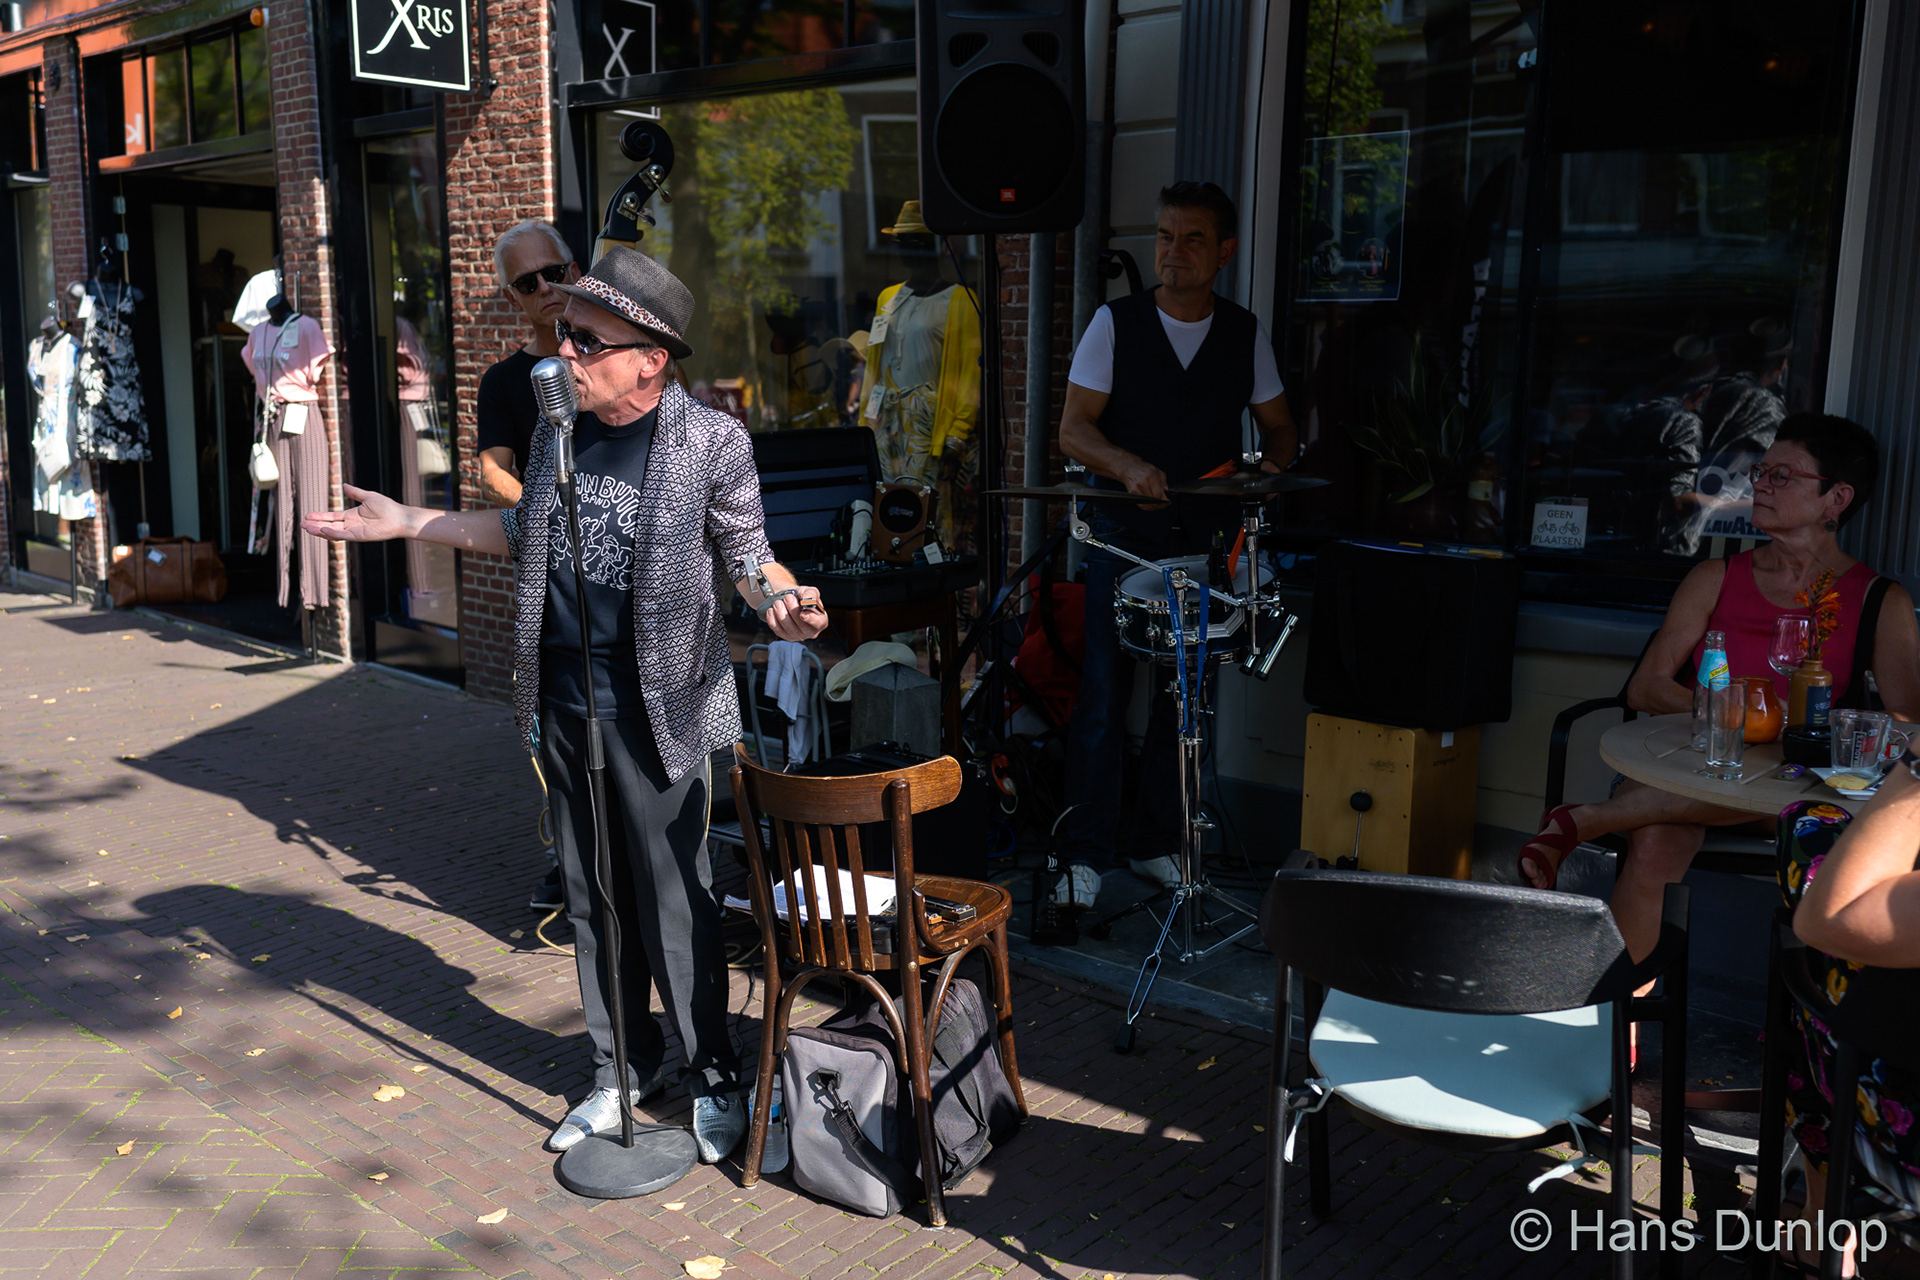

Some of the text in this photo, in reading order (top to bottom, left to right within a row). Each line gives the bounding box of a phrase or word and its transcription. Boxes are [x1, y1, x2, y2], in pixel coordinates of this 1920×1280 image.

[581, 493, 611, 509] BAND
[1547, 509, 1574, 519] GEEN
[1533, 534, 1582, 546] PLAATSEN
